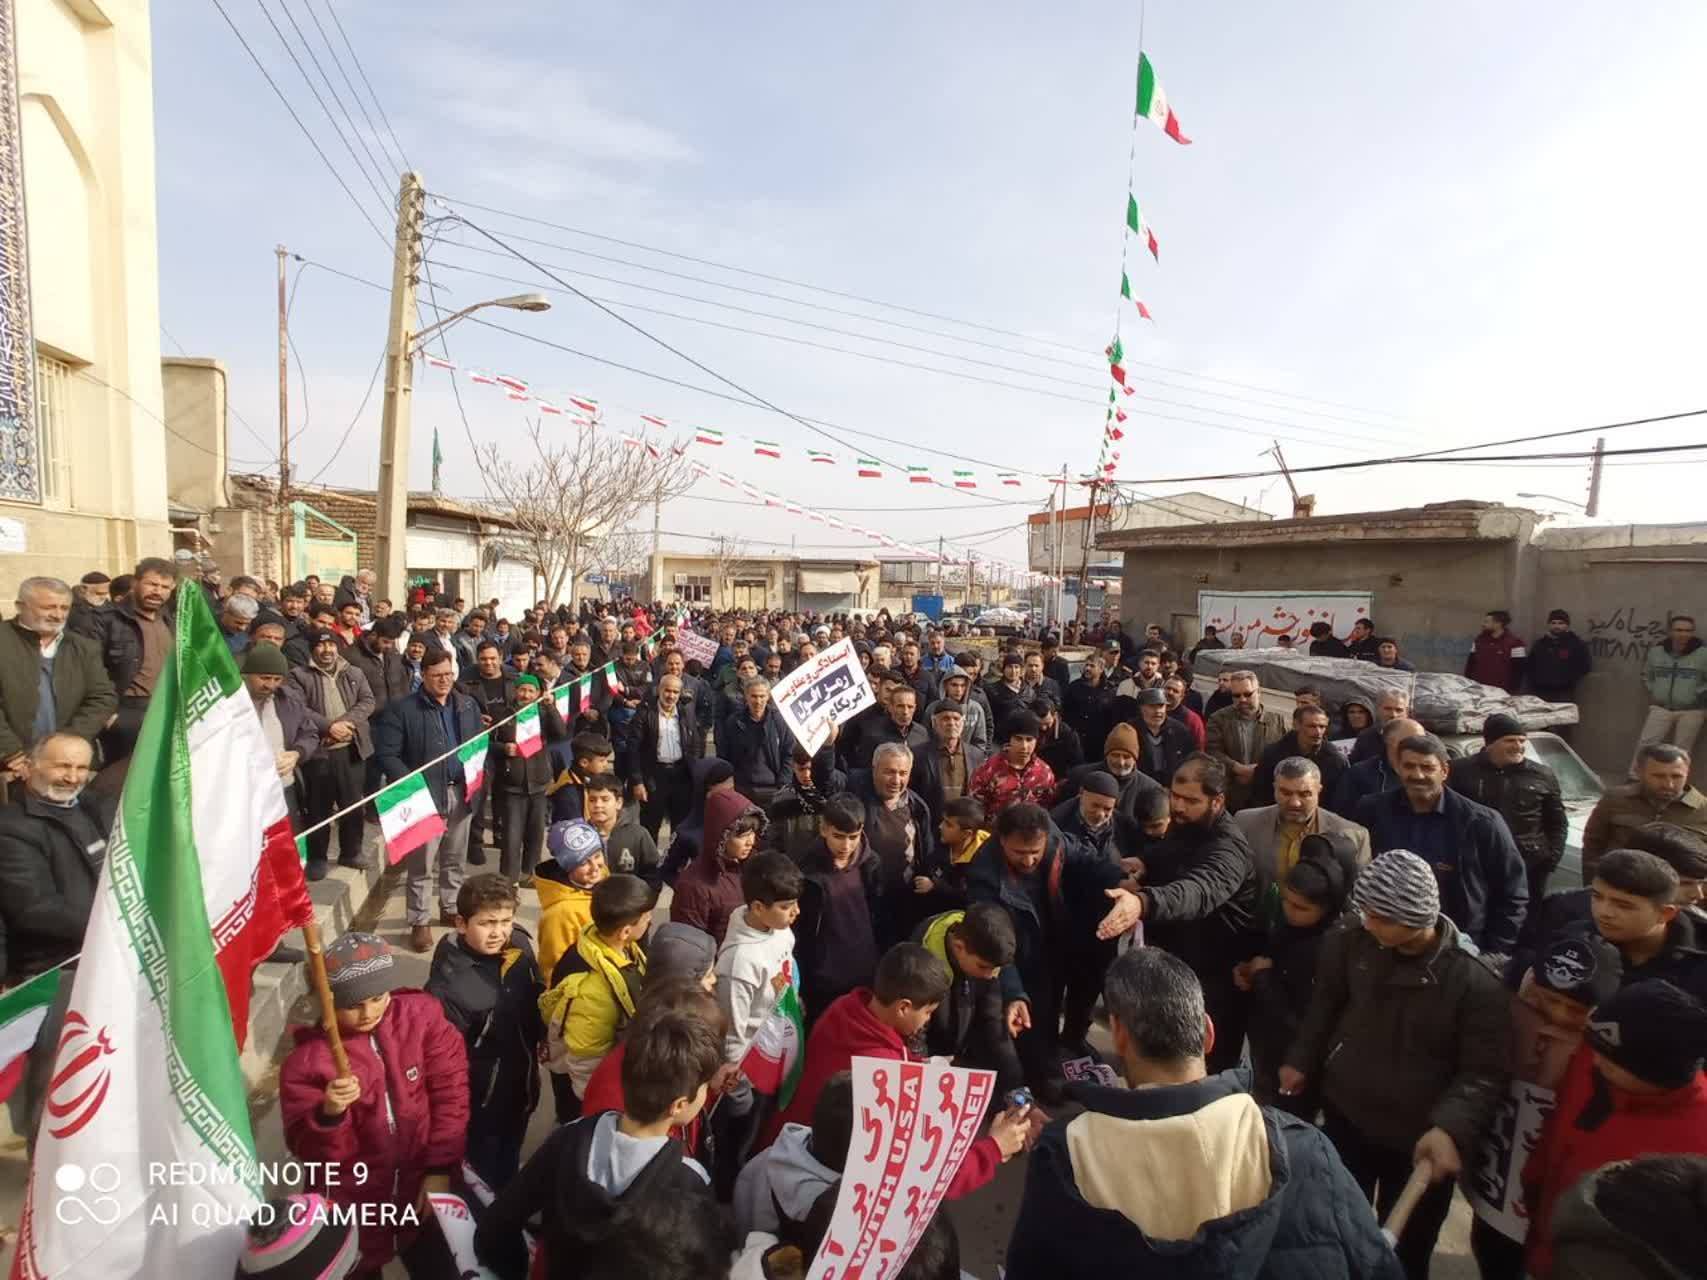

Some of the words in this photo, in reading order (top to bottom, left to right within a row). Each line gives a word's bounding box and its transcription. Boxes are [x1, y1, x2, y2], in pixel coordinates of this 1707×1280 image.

[825, 675, 848, 700] رمز
[861, 1068, 897, 1163] مرگ
[920, 1072, 959, 1172] مرگ
[935, 1074, 989, 1193] ISRAEL
[849, 1174, 899, 1268] WITH
[890, 1077, 921, 1164] U.S.A
[852, 1183, 875, 1232] بر
